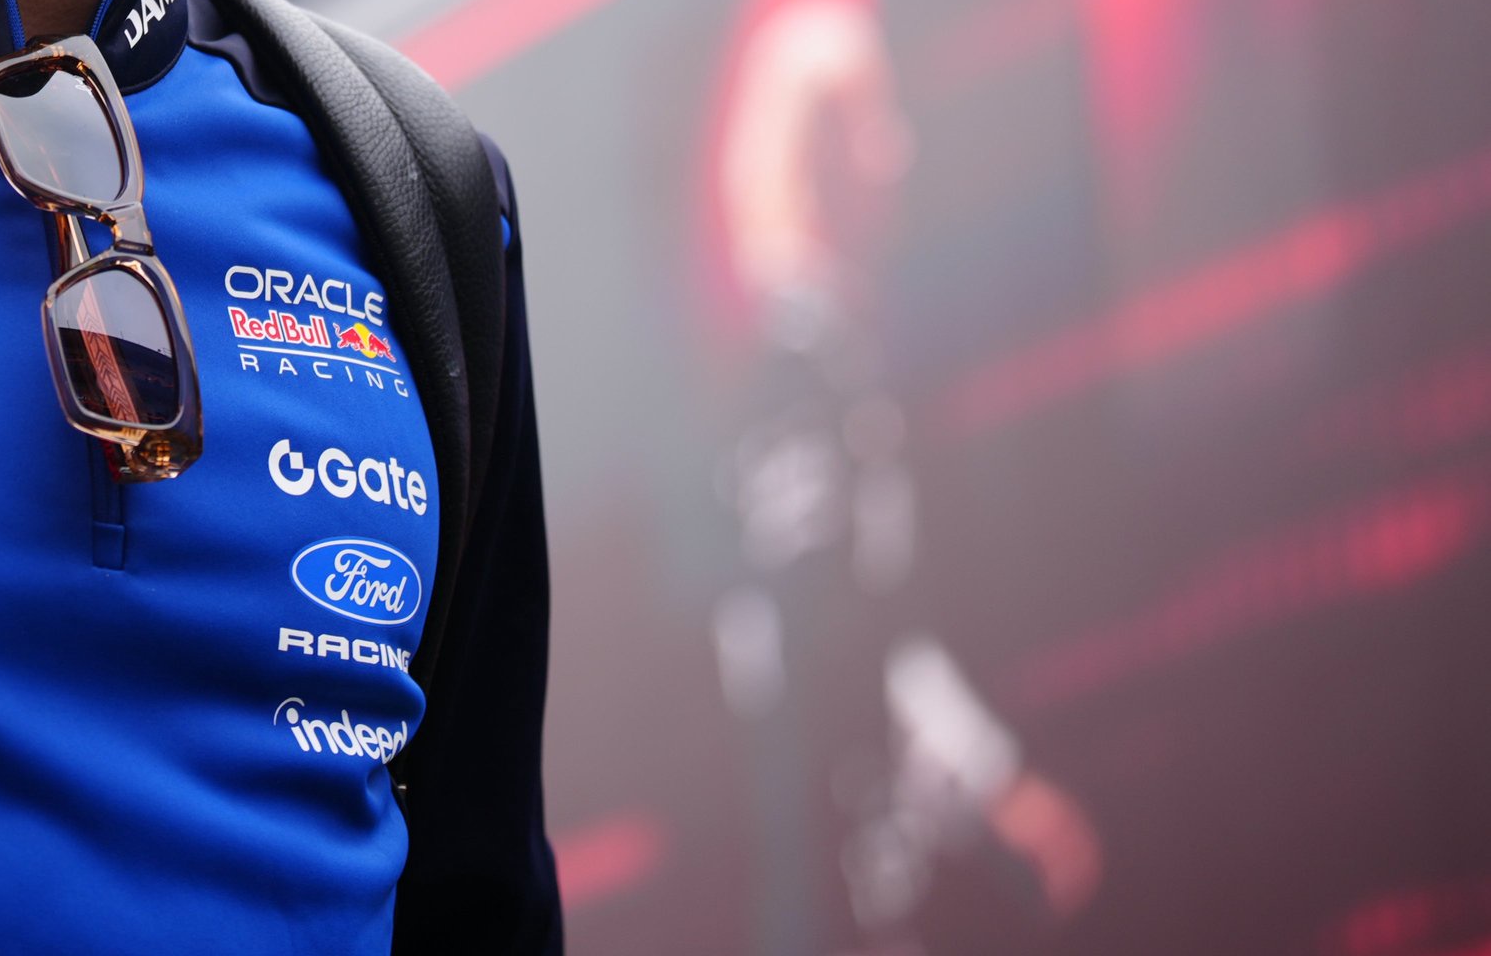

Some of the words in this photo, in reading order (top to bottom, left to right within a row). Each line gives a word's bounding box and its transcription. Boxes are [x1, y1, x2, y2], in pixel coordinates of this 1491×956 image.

[225, 265, 384, 327] ORACLE
[227, 306, 284, 342] Red
[278, 312, 331, 348] Bull
[239, 353, 408, 398] RACING
[317, 447, 428, 516] Gate
[325, 548, 407, 614] Ford
[278, 627, 411, 674] RACING
[286, 707, 408, 765] indeed
